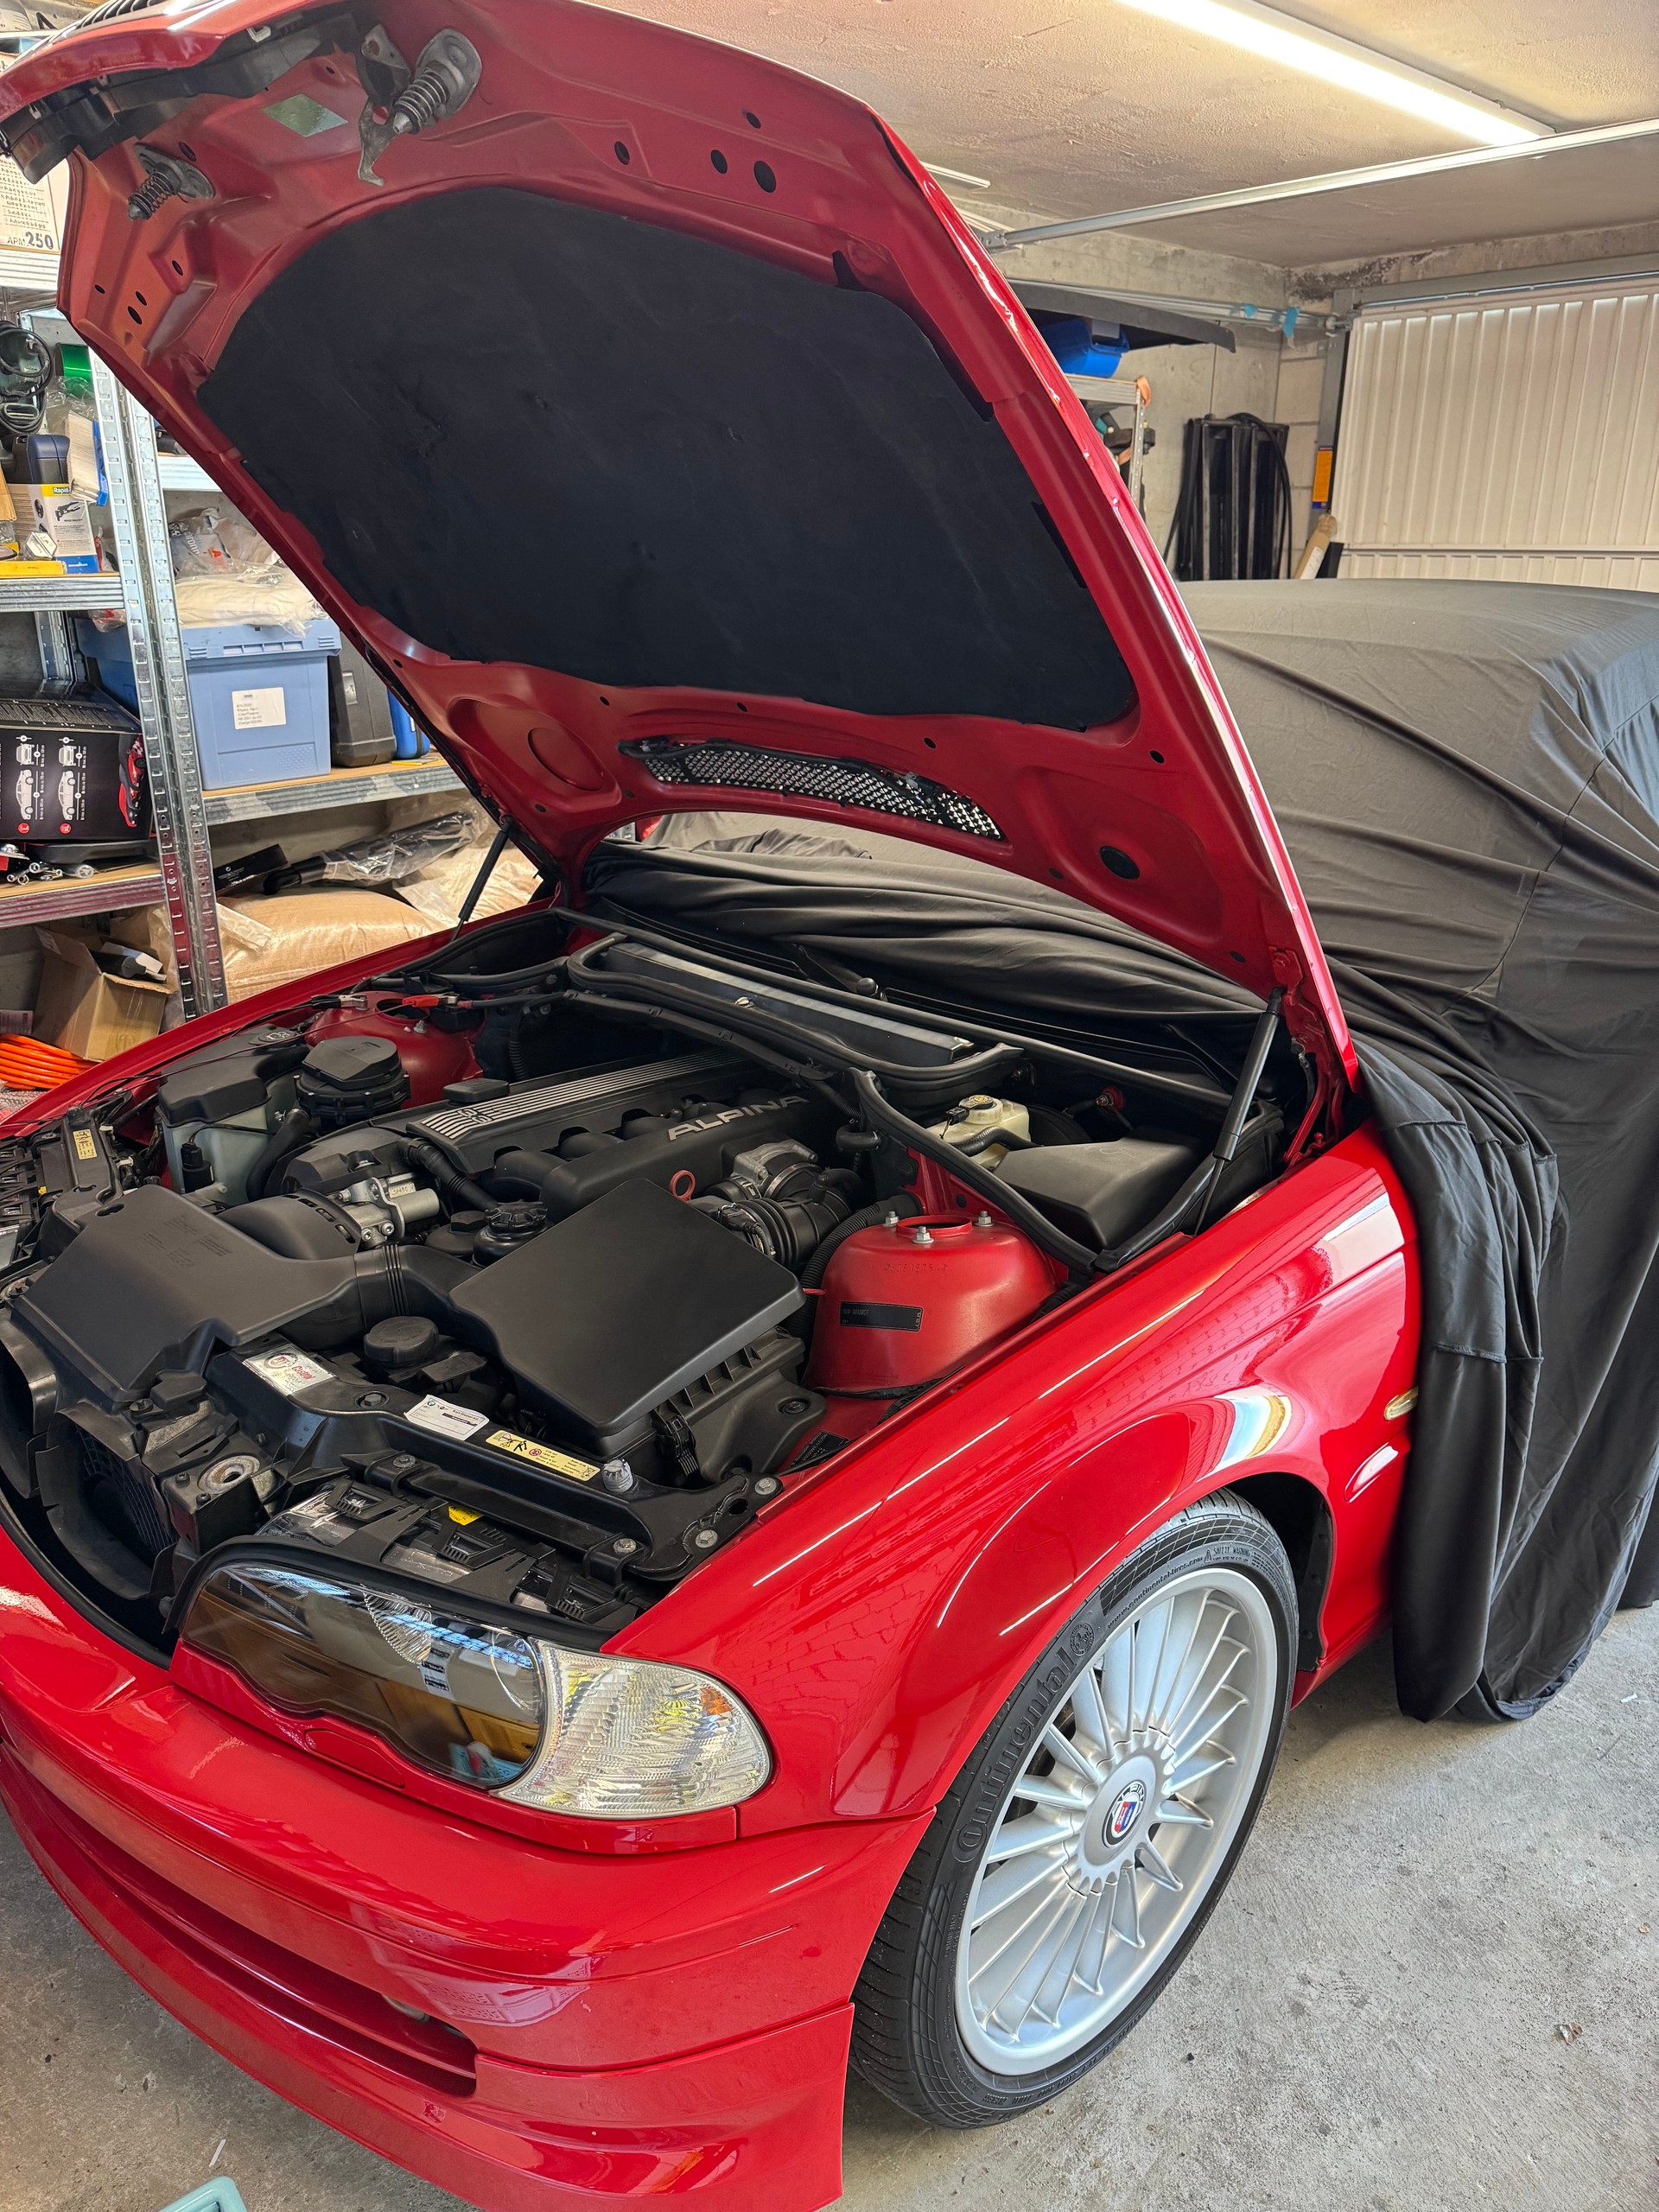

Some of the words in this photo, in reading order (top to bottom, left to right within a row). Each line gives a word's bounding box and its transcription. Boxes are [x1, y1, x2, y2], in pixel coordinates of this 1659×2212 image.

[25, 231, 54, 250] 250
[668, 1095, 810, 1141] ALPINA
[952, 1646, 1077, 1863] Continental
